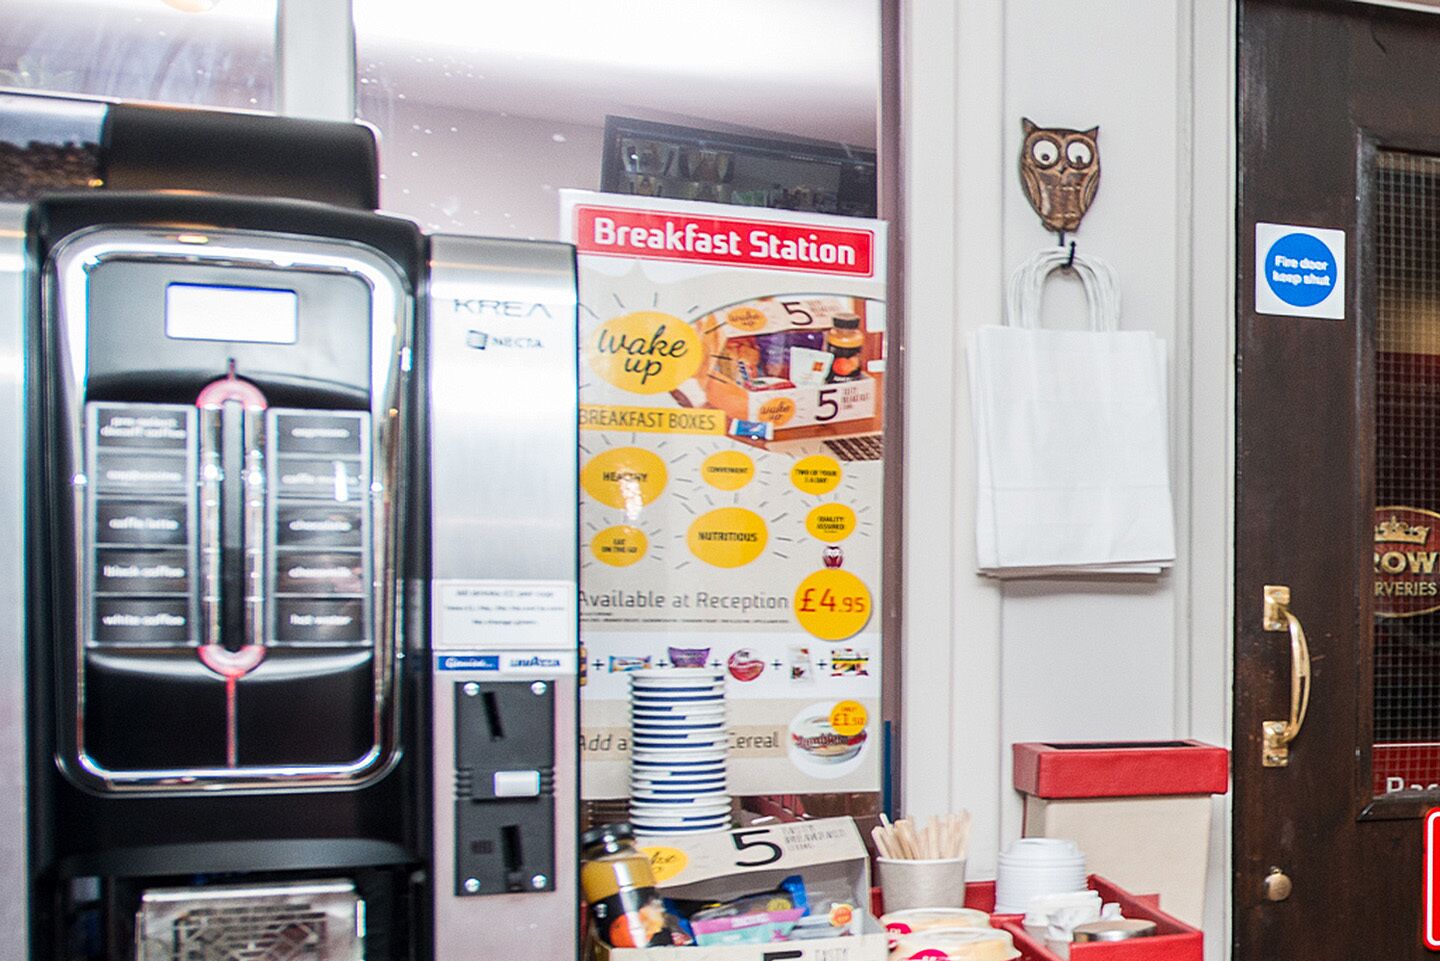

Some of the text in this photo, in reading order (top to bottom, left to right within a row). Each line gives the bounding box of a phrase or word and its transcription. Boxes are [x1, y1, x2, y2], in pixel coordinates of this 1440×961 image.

[593, 217, 857, 266] Breakfast Station
[1274, 255, 1329, 271] Fire door
[1272, 270, 1331, 287] keep shut
[453, 298, 553, 319] KREA
[781, 301, 813, 326] 5
[492, 336, 545, 348] NECTA
[597, 324, 688, 358] wake
[624, 357, 663, 385] up
[815, 388, 838, 422] 5
[579, 408, 716, 431] BREAKFAST BOXES
[697, 531, 758, 542] NUTRITIOUS
[579, 590, 789, 613] Available at Reception
[799, 587, 866, 613] £4.95
[731, 828, 783, 867] 5
